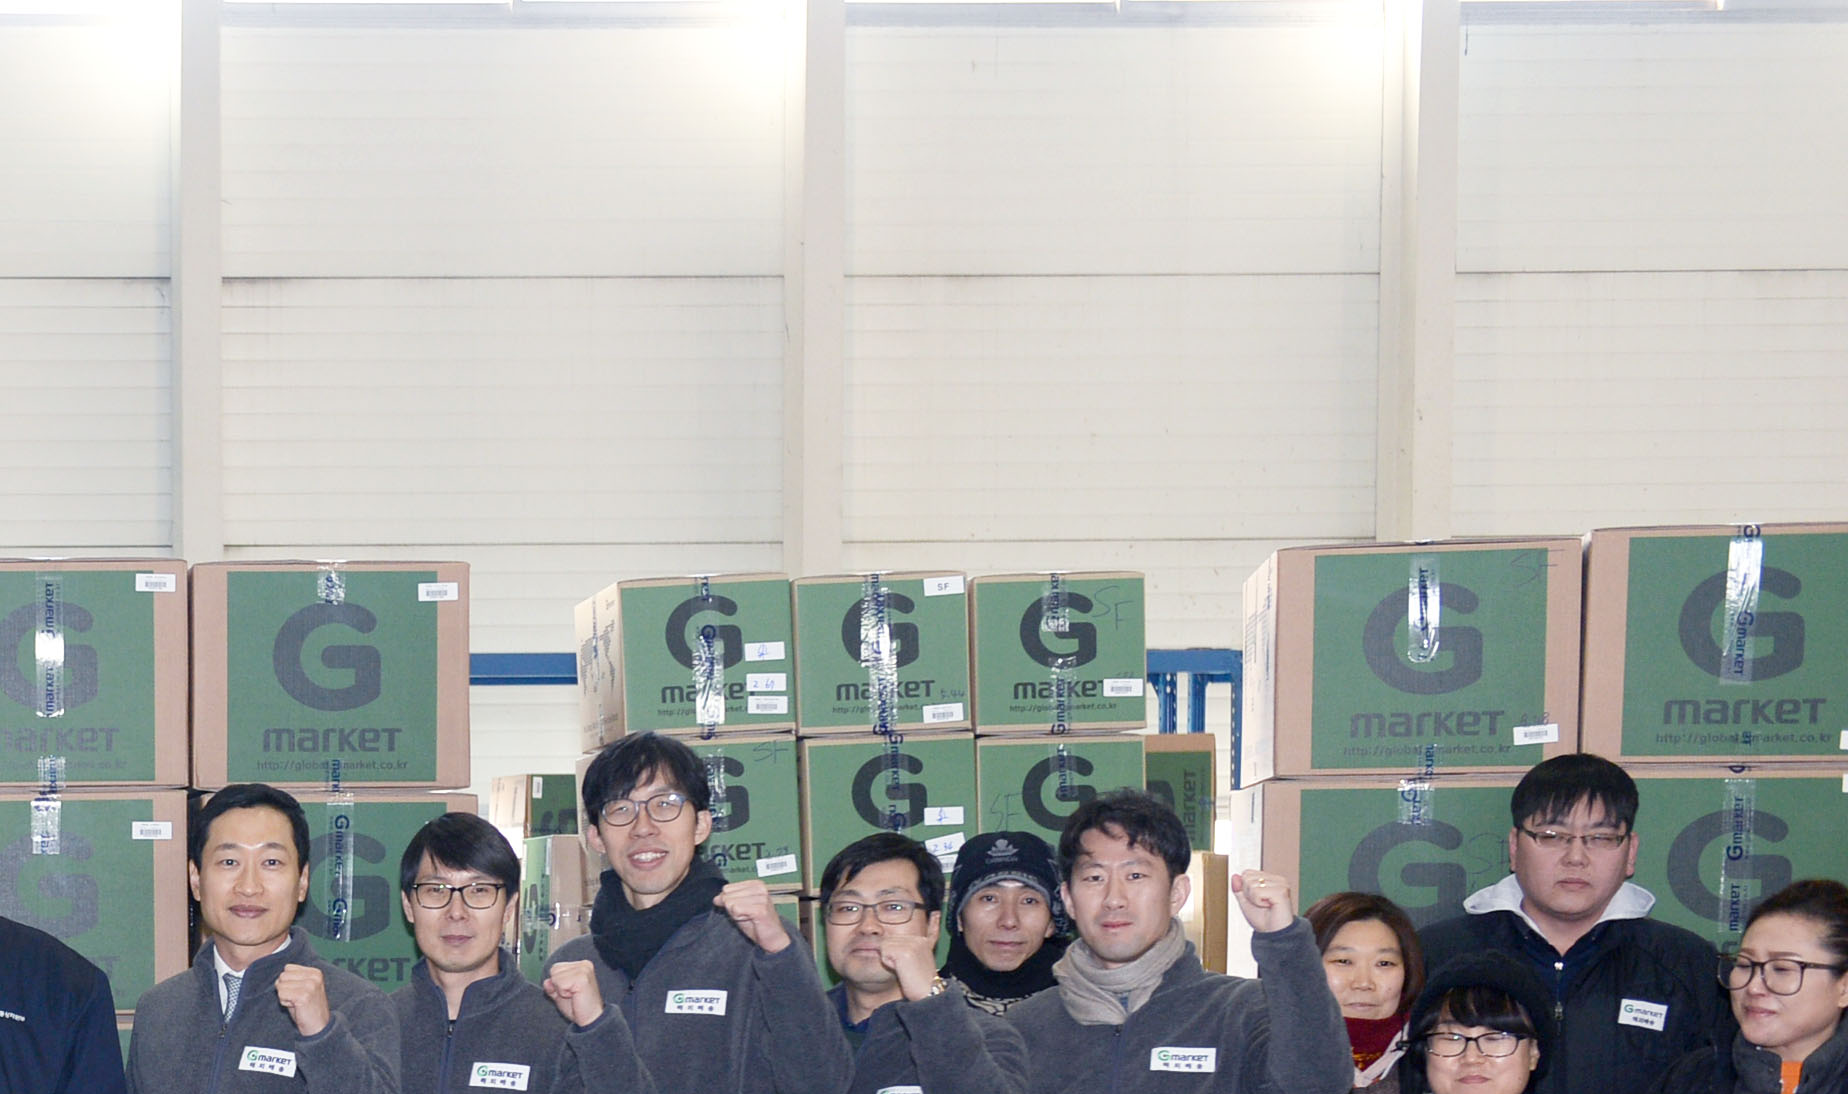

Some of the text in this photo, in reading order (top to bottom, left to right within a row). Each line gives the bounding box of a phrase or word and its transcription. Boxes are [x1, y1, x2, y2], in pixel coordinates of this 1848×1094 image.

[937, 582, 950, 591] SF
[665, 595, 743, 670] G
[841, 592, 920, 668] G
[1020, 592, 1097, 669] G
[1363, 582, 1483, 694] G
[1679, 566, 1805, 682] G
[1733, 610, 1754, 675] Gmarket
[273, 603, 382, 711] G
[836, 679, 936, 701] maket
[1662, 698, 1828, 725] market
[262, 728, 402, 753] market
[1350, 710, 1504, 739] market
[852, 753, 927, 831] G
[334, 815, 350, 877] Gmarket
[1726, 796, 1744, 861] Gmarket
[303, 832, 390, 942] G
[1348, 819, 1467, 932] G
[1667, 810, 1793, 924] G
[673, 993, 721, 1004] Gmarket
[247, 1049, 293, 1066] Gmarket
[477, 1065, 524, 1079] Gmarket
[1158, 1049, 1209, 1062] Gmarket
